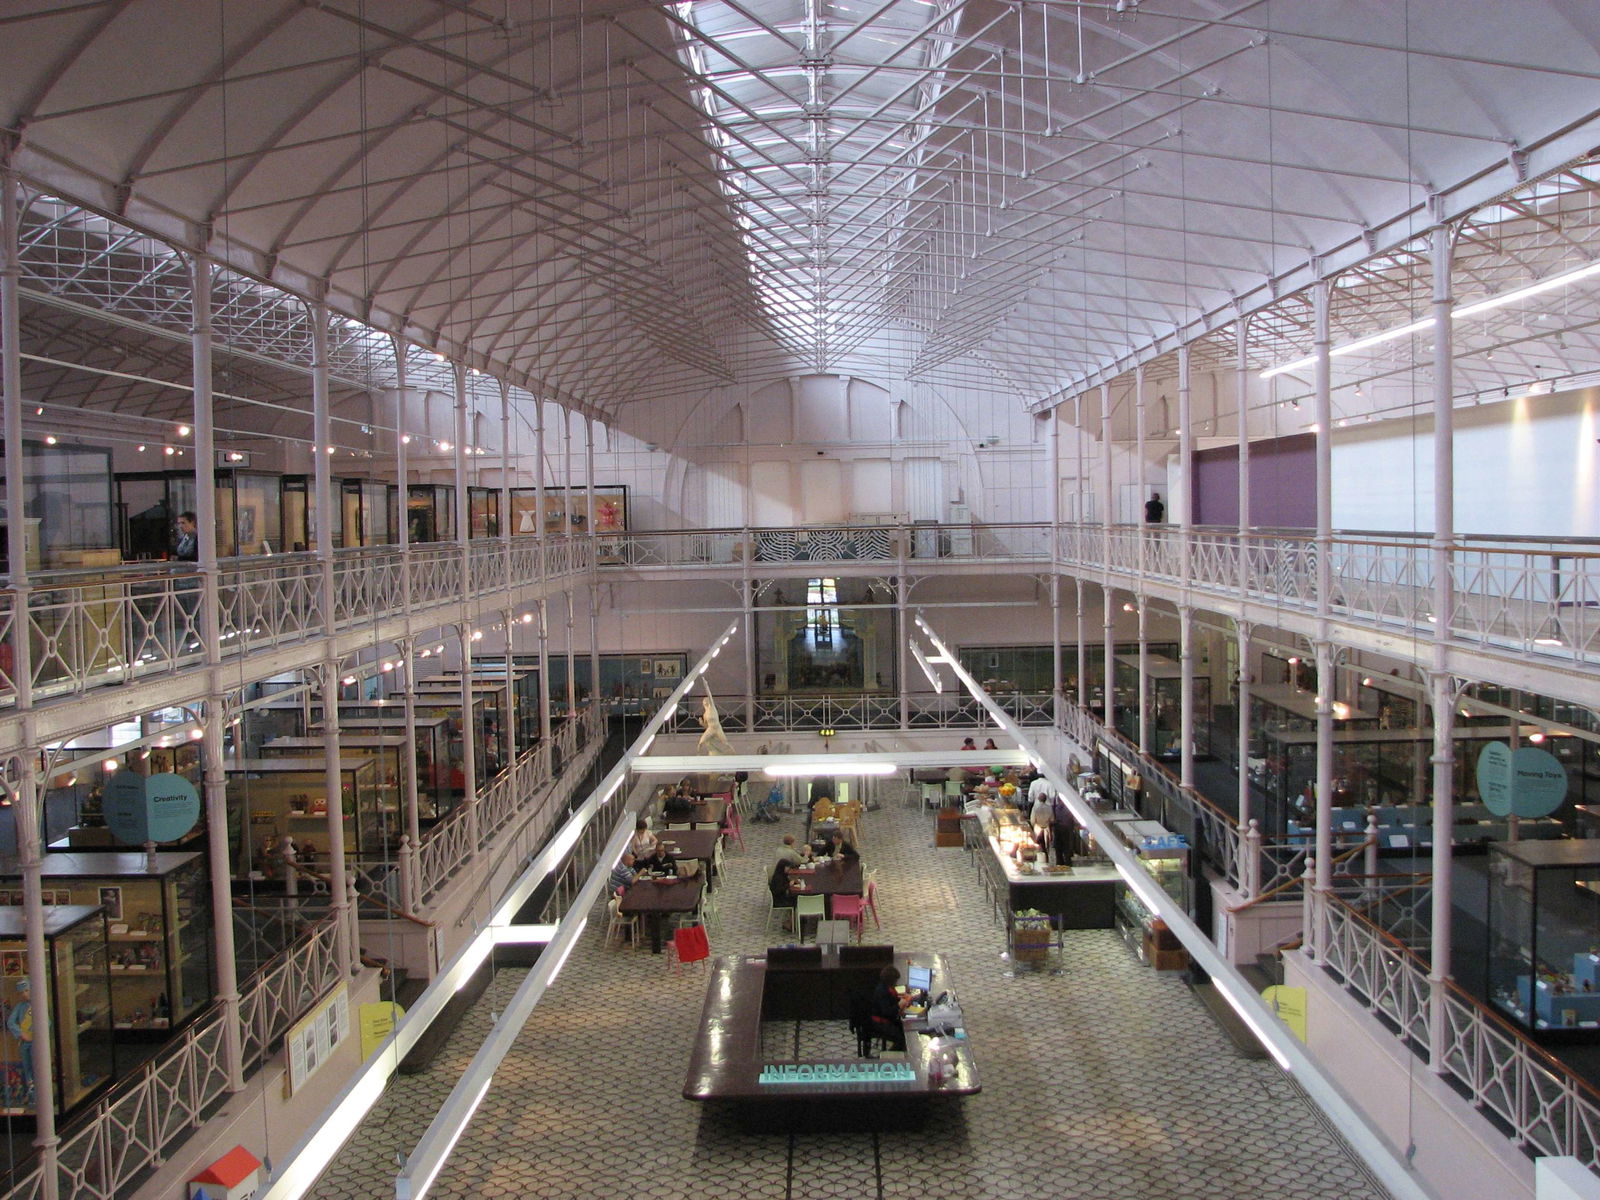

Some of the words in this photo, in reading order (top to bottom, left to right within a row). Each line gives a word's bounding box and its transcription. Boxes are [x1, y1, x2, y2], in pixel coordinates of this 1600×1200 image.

[1517, 770, 1543, 779] Moving
[153, 794, 188, 803] Creativity
[763, 1062, 911, 1081] INFORMATION
